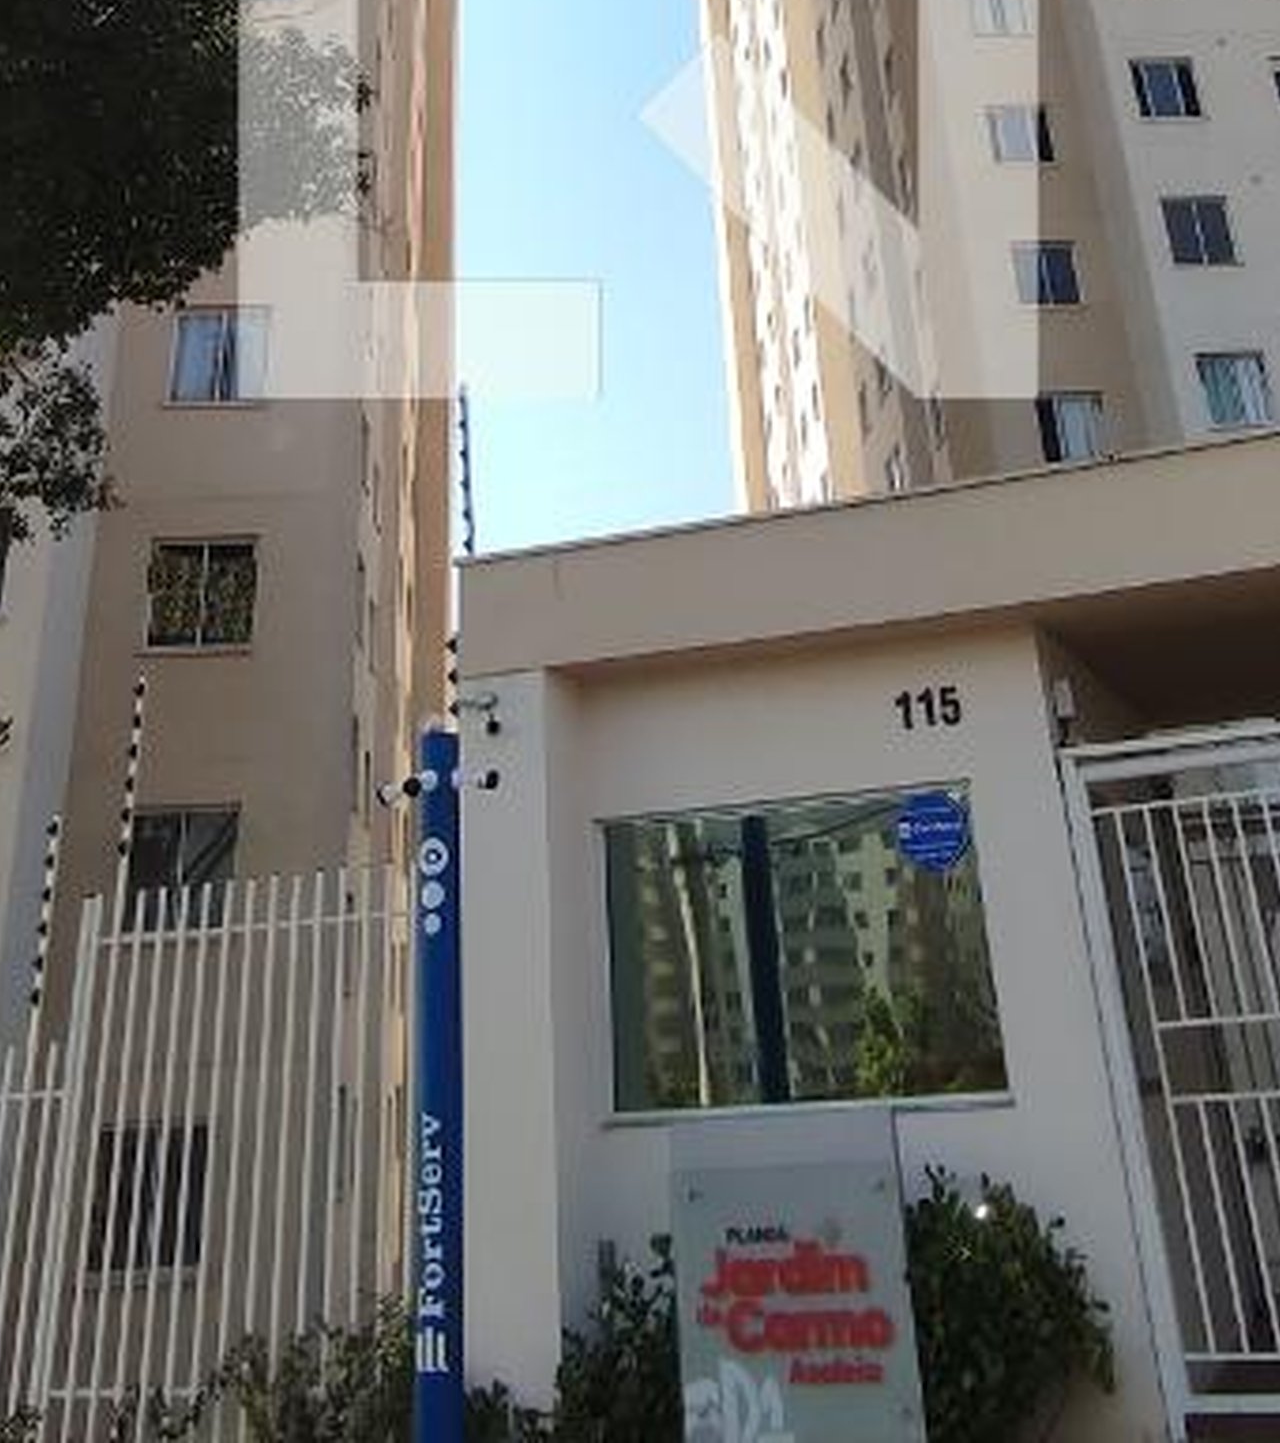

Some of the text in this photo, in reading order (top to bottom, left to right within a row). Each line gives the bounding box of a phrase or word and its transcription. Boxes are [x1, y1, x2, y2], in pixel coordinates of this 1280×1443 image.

[895, 686, 961, 730] 115
[417, 1112, 446, 1319] FortServ
[701, 1239, 868, 1297] Jardim
[728, 1295, 895, 1353] Carmo
